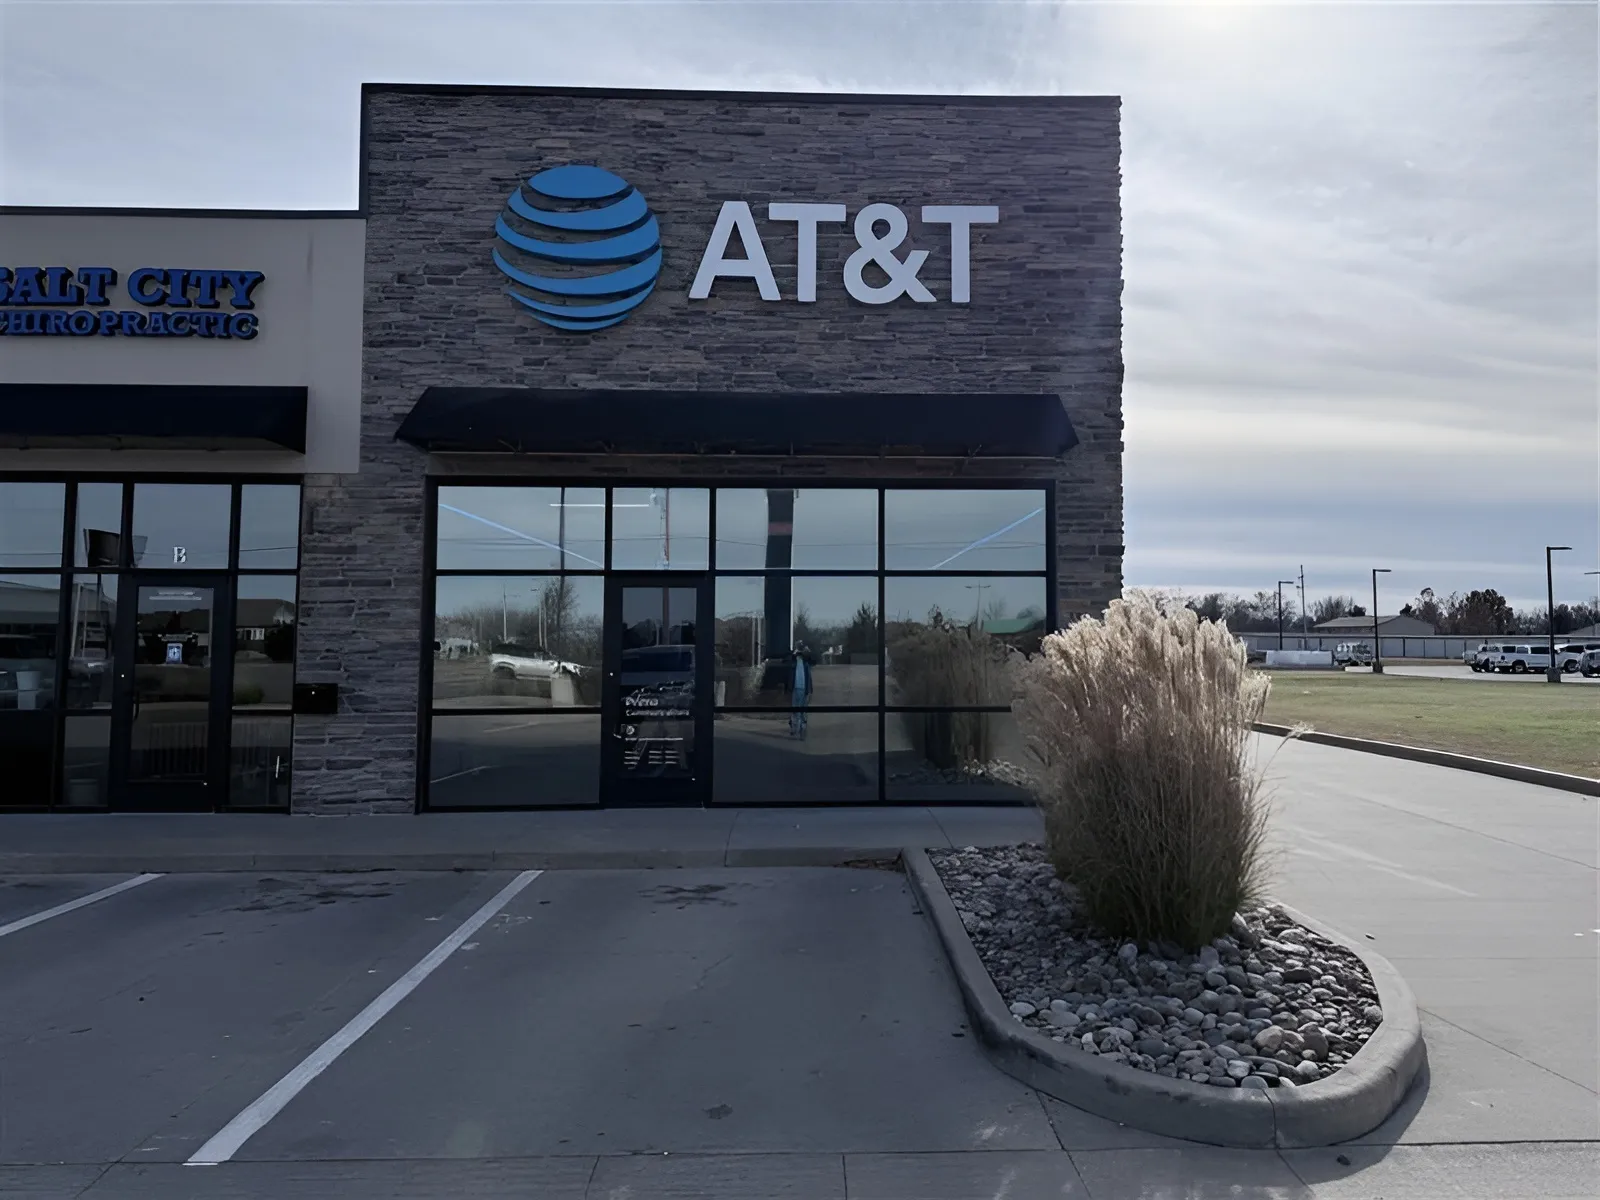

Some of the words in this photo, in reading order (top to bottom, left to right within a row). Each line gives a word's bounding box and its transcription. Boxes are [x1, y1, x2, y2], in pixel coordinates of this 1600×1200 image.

[688, 201, 999, 304] AT&T
[127, 268, 264, 309] CITY
[0, 310, 259, 340] HIROPRACTIC
